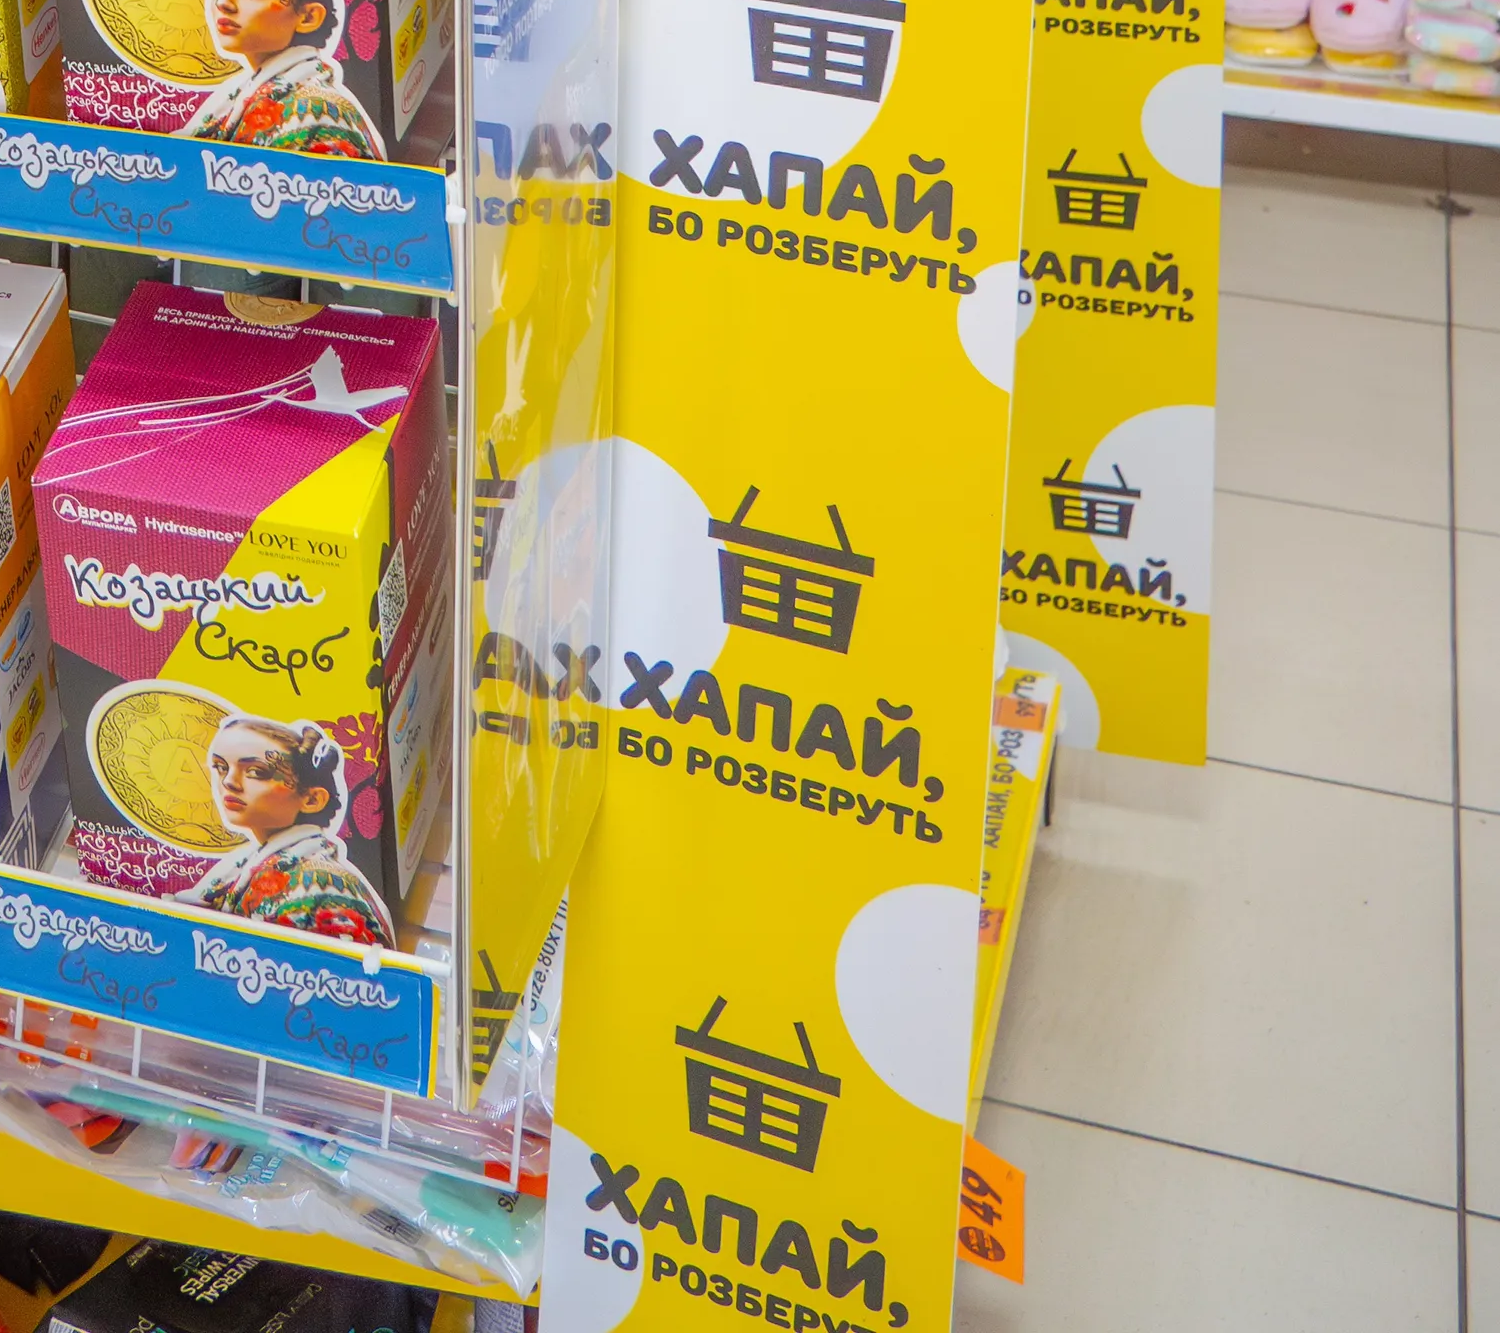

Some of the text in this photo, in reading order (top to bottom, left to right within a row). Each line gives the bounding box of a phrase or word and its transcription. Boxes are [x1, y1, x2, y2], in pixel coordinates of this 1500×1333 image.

[1044, 17, 1201, 44] РОЗБЕРУТЬ
[202, 150, 416, 221] Козацький
[649, 128, 978, 254] ХАПАЙ,
[69, 183, 189, 247] Скарб
[302, 214, 427, 280] Скарб
[648, 205, 977, 296] БО РОЗБЕРУТЬ
[1041, 292, 1194, 324] РОЗБЕРУТЬ
[249, 529, 302, 554] LOVE
[307, 537, 348, 560] YOU
[1001, 548, 1187, 607] ХАПАЙ,
[63, 553, 326, 632] Козацький
[1037, 591, 1187, 628] РОЗБЕРУТЬ
[195, 620, 351, 695] Скарб
[619, 649, 944, 801] ХАПАЙ,
[618, 726, 943, 845] БО РОЗБЕРУТЬ
[192, 929, 399, 1010] Козацький
[57, 949, 177, 1018] Скарб
[283, 1001, 409, 1076] Скарб
[584, 1227, 639, 1272] БО
[585, 1152, 909, 1329] ХАПАЙ,
